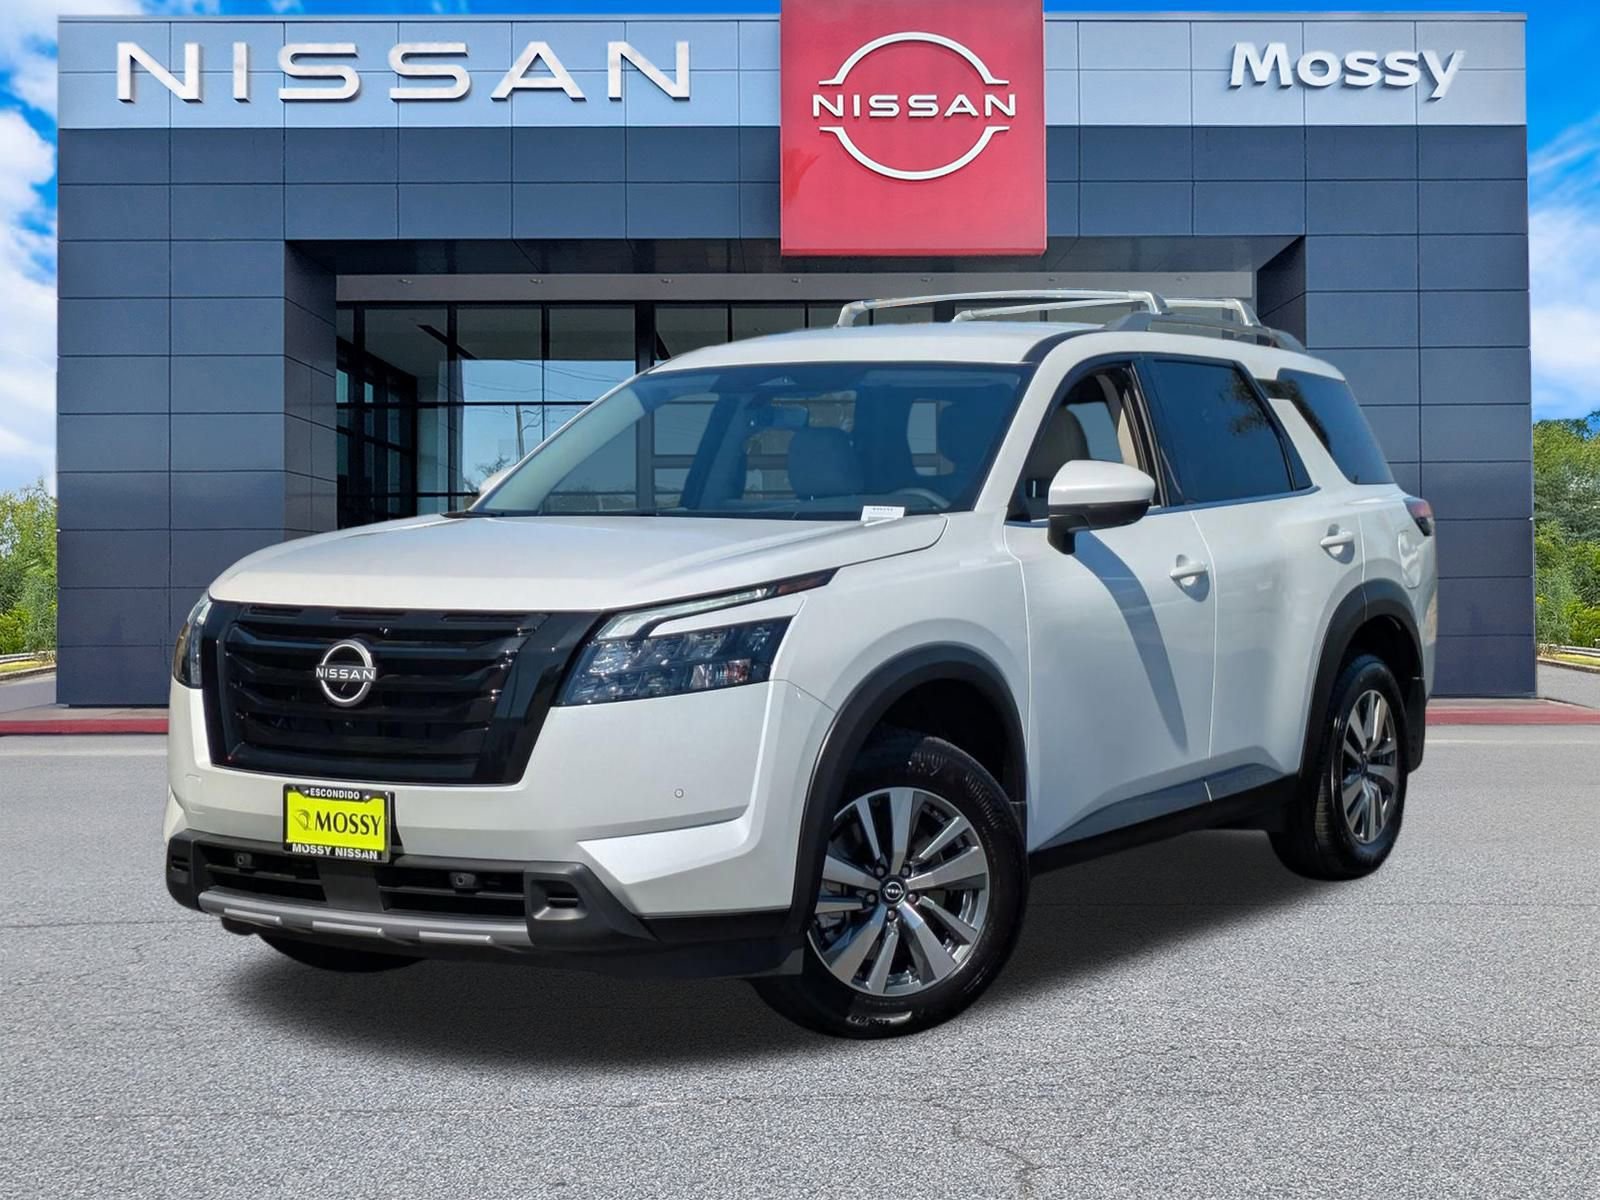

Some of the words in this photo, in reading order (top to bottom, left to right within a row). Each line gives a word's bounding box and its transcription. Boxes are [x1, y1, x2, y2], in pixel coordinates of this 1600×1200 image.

[116, 41, 692, 103] NISSAN
[1229, 41, 1466, 101] Mossy
[811, 92, 1017, 119] NISSAN
[315, 667, 375, 680] NISSAN
[309, 787, 361, 800] ESCONDIDO
[314, 810, 382, 837] MOSSY
[291, 842, 333, 856] MOSSY
[334, 846, 379, 860] NISSAN
